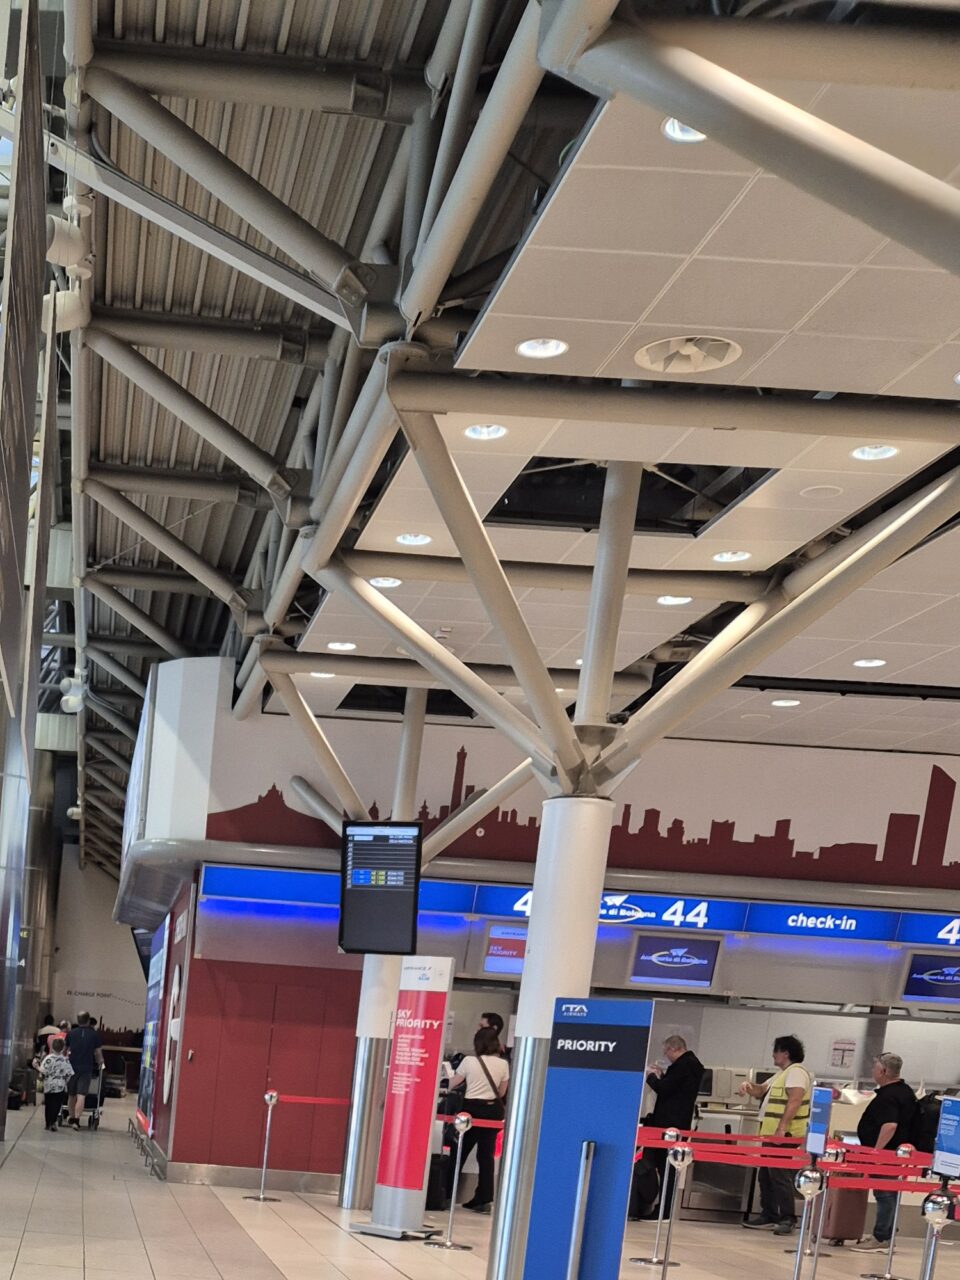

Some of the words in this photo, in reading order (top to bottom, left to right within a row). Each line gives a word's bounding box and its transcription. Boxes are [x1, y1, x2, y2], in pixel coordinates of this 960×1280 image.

[513, 890, 533, 917] 4
[619, 908, 657, 919] Bologna
[661, 899, 708, 928] 44
[787, 912, 857, 931] check-in
[937, 918, 960, 944] 4
[397, 1009, 413, 1018] SKY
[561, 1003, 588, 1013] ITA
[395, 1018, 441, 1030] PRIORITY
[556, 1039, 617, 1053] PRIORITY
